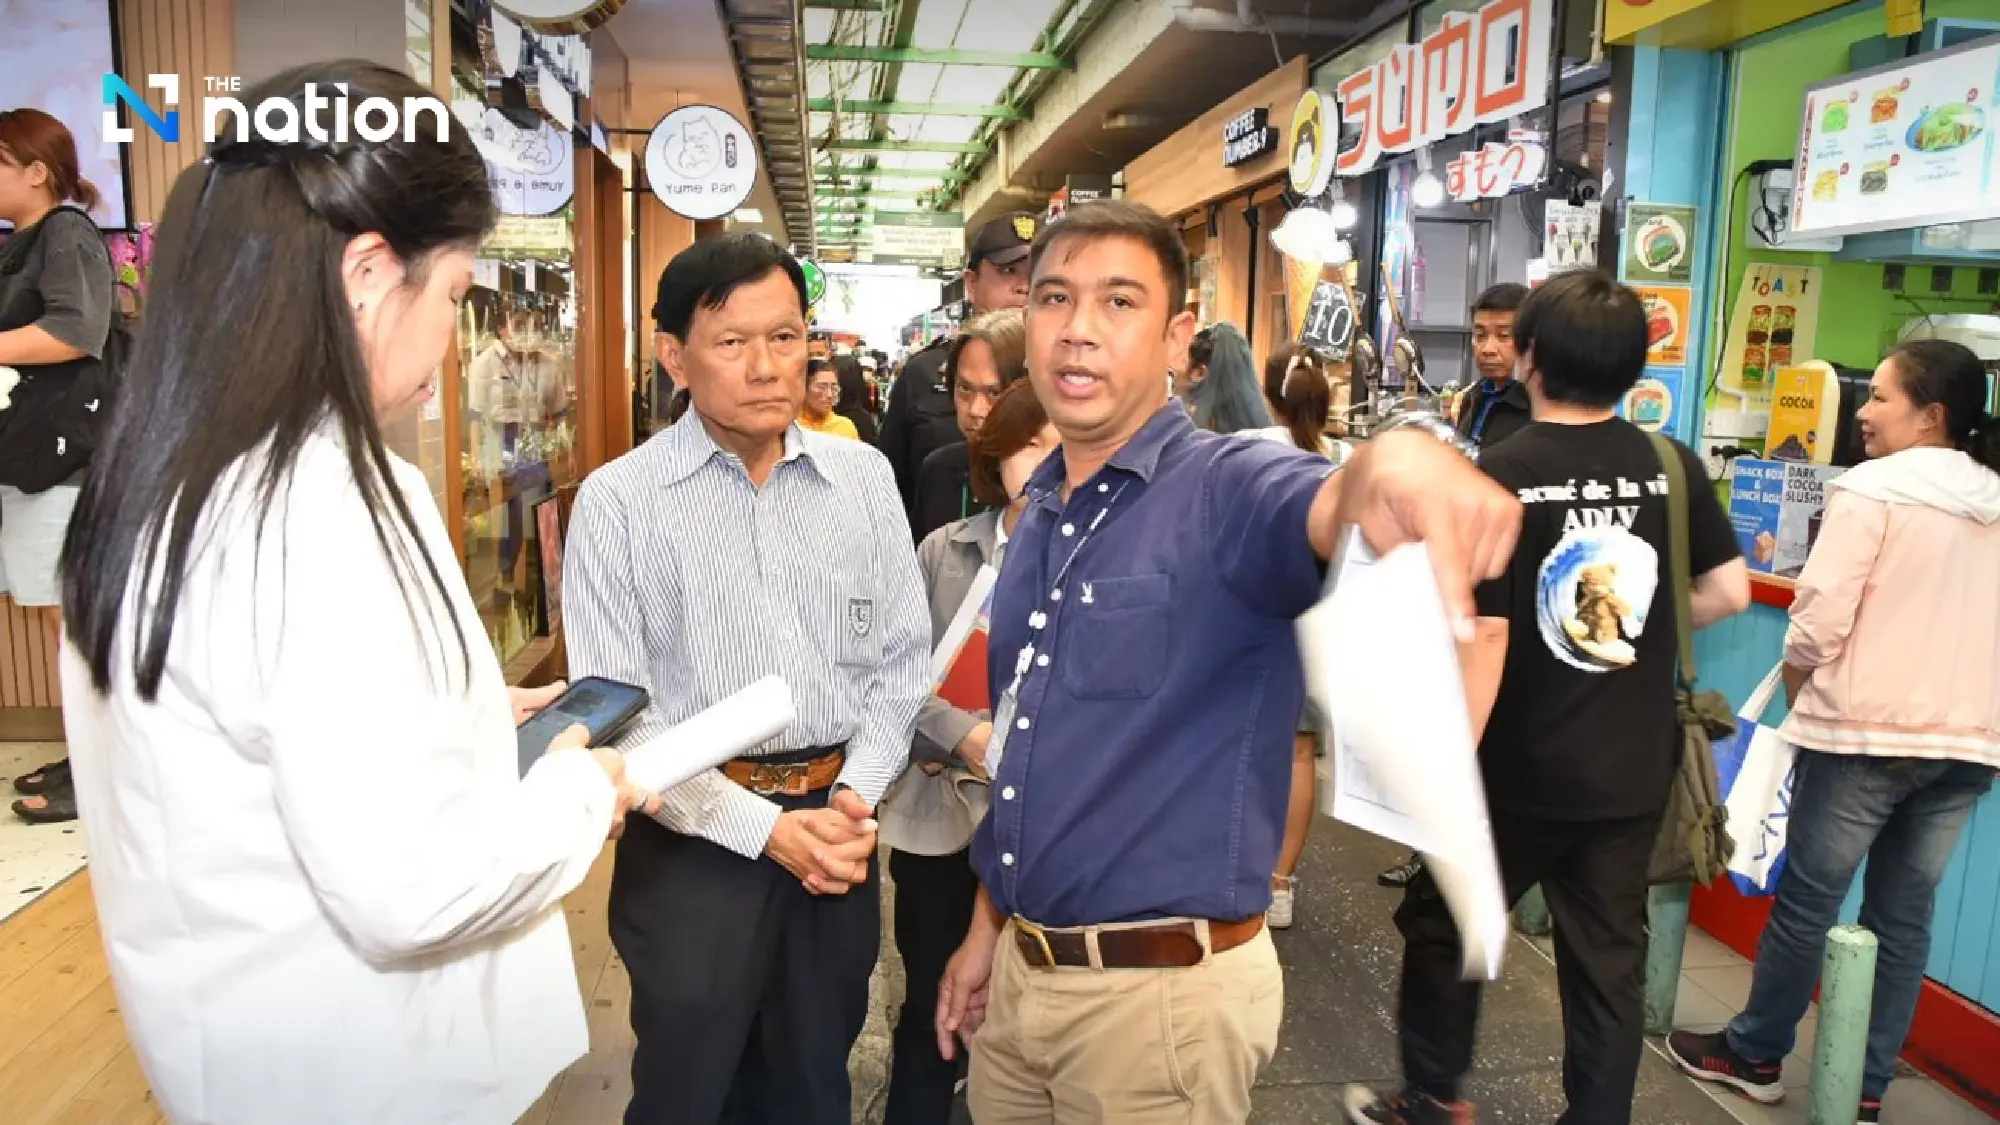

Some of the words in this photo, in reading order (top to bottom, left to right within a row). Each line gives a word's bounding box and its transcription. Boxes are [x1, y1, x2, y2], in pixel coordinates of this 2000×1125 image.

[1224, 108, 1256, 143] COFFEE
[664, 181, 704, 195] Yume
[710, 181, 737, 194] Pan
[1751, 274, 1809, 298] TOAST
[1304, 300, 1353, 346] 10
[1780, 395, 1815, 409] COCOA
[1788, 466, 1816, 478] DARK
[1581, 479, 1612, 500] de
[1615, 476, 1641, 498] la
[1644, 473, 1670, 495] vi
[1787, 478, 1823, 491] COCOA
[1786, 491, 1823, 504] SLUSHY
[1562, 505, 1641, 530] ADLV
